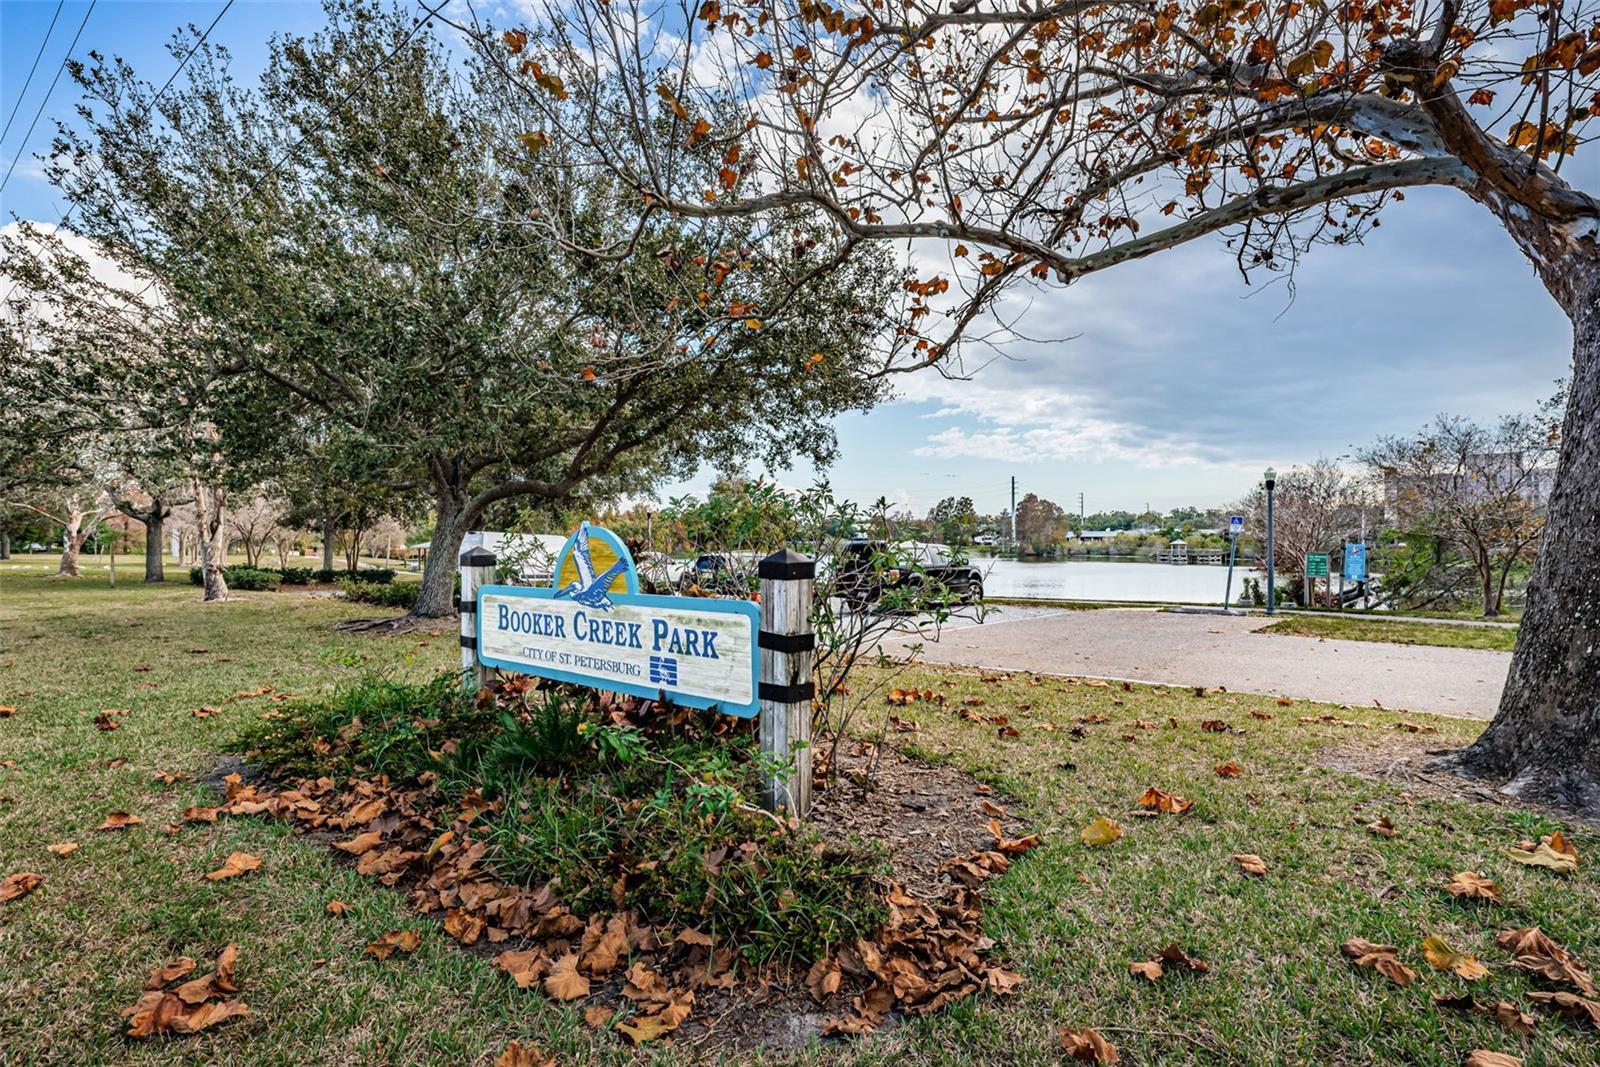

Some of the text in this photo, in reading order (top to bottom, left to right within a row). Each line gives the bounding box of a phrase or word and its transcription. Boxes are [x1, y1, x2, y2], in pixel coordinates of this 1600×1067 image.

[498, 604, 719, 659] BOOKER CREEK PARK
[522, 647, 641, 677] CITY OF ST. PETERSBURG
